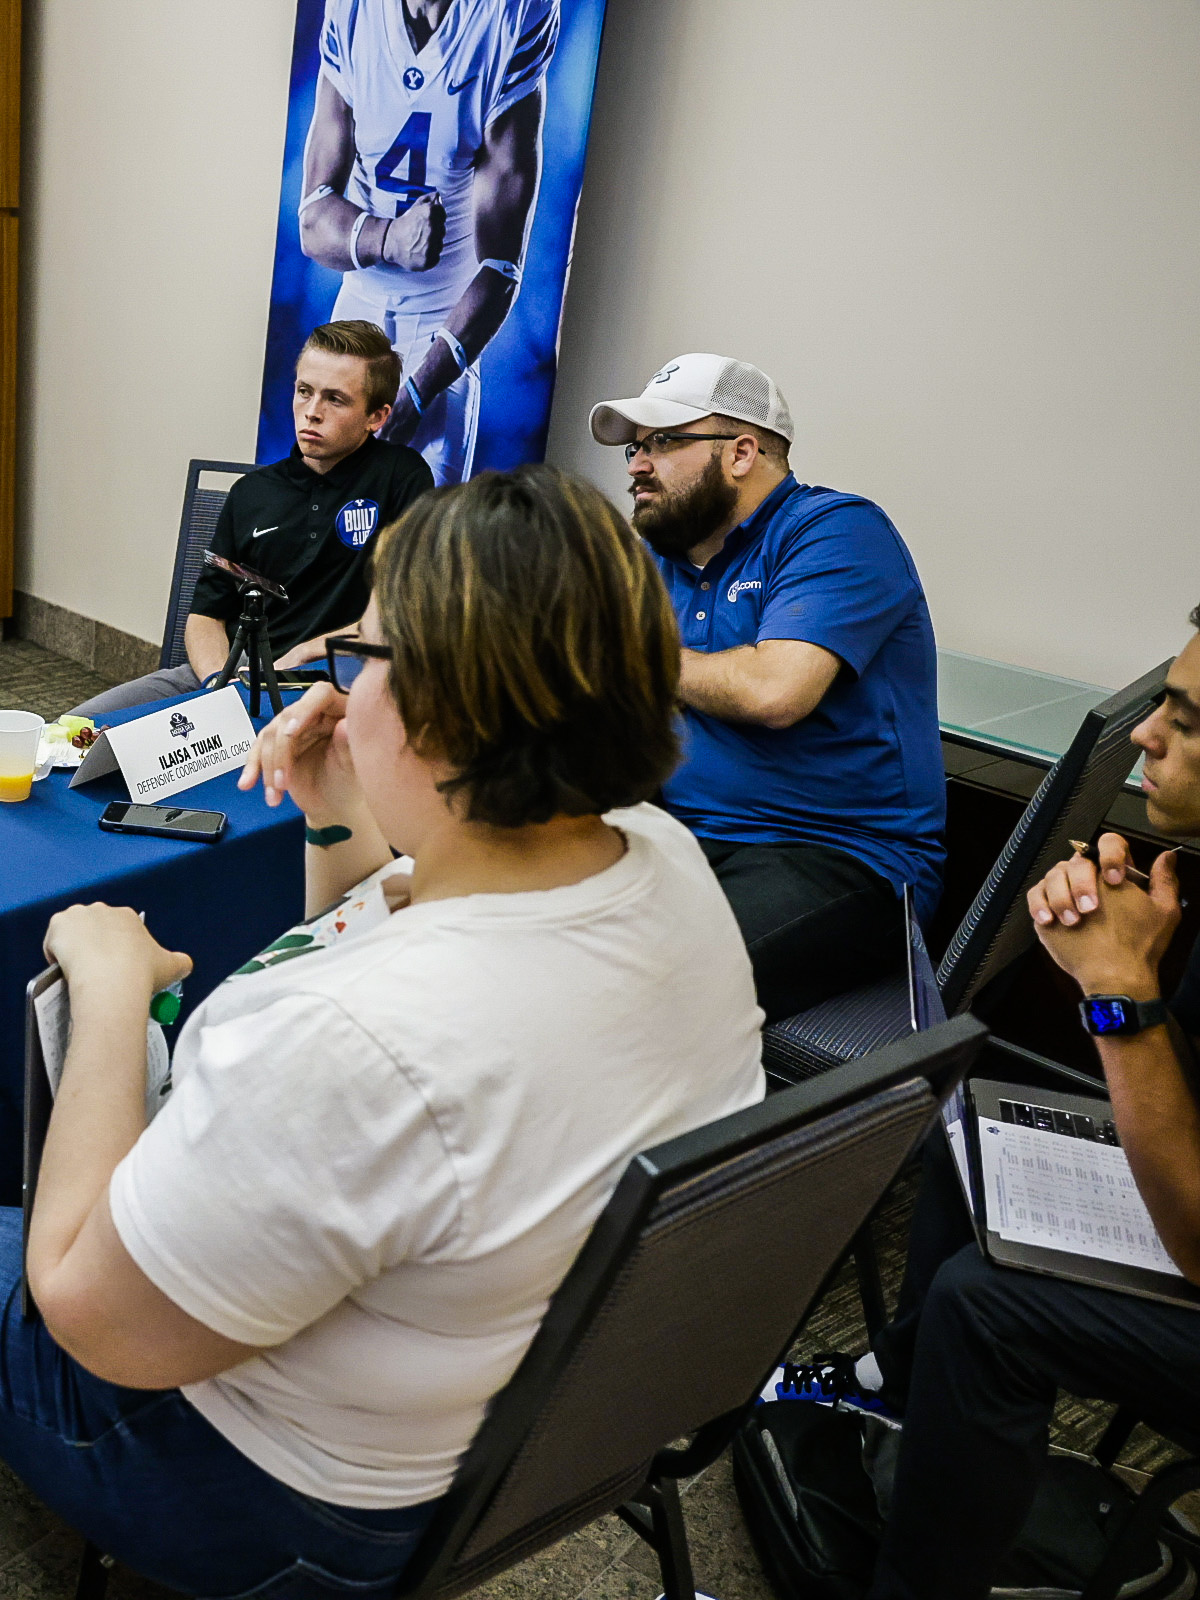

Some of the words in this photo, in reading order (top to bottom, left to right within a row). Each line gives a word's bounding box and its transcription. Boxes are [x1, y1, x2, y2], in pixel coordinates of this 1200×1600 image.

[407, 70, 421, 88] Y
[375, 112, 438, 219] 4
[354, 498, 364, 507] Y
[343, 506, 377, 533] BUILT
[136, 770, 176, 795] DEFENSIVE
[175, 749, 231, 779] COORDINATOR/DL
[230, 739, 251, 757] COACH
[158, 747, 192, 771] ILAISA
[189, 734, 223, 758] TUIAKI
